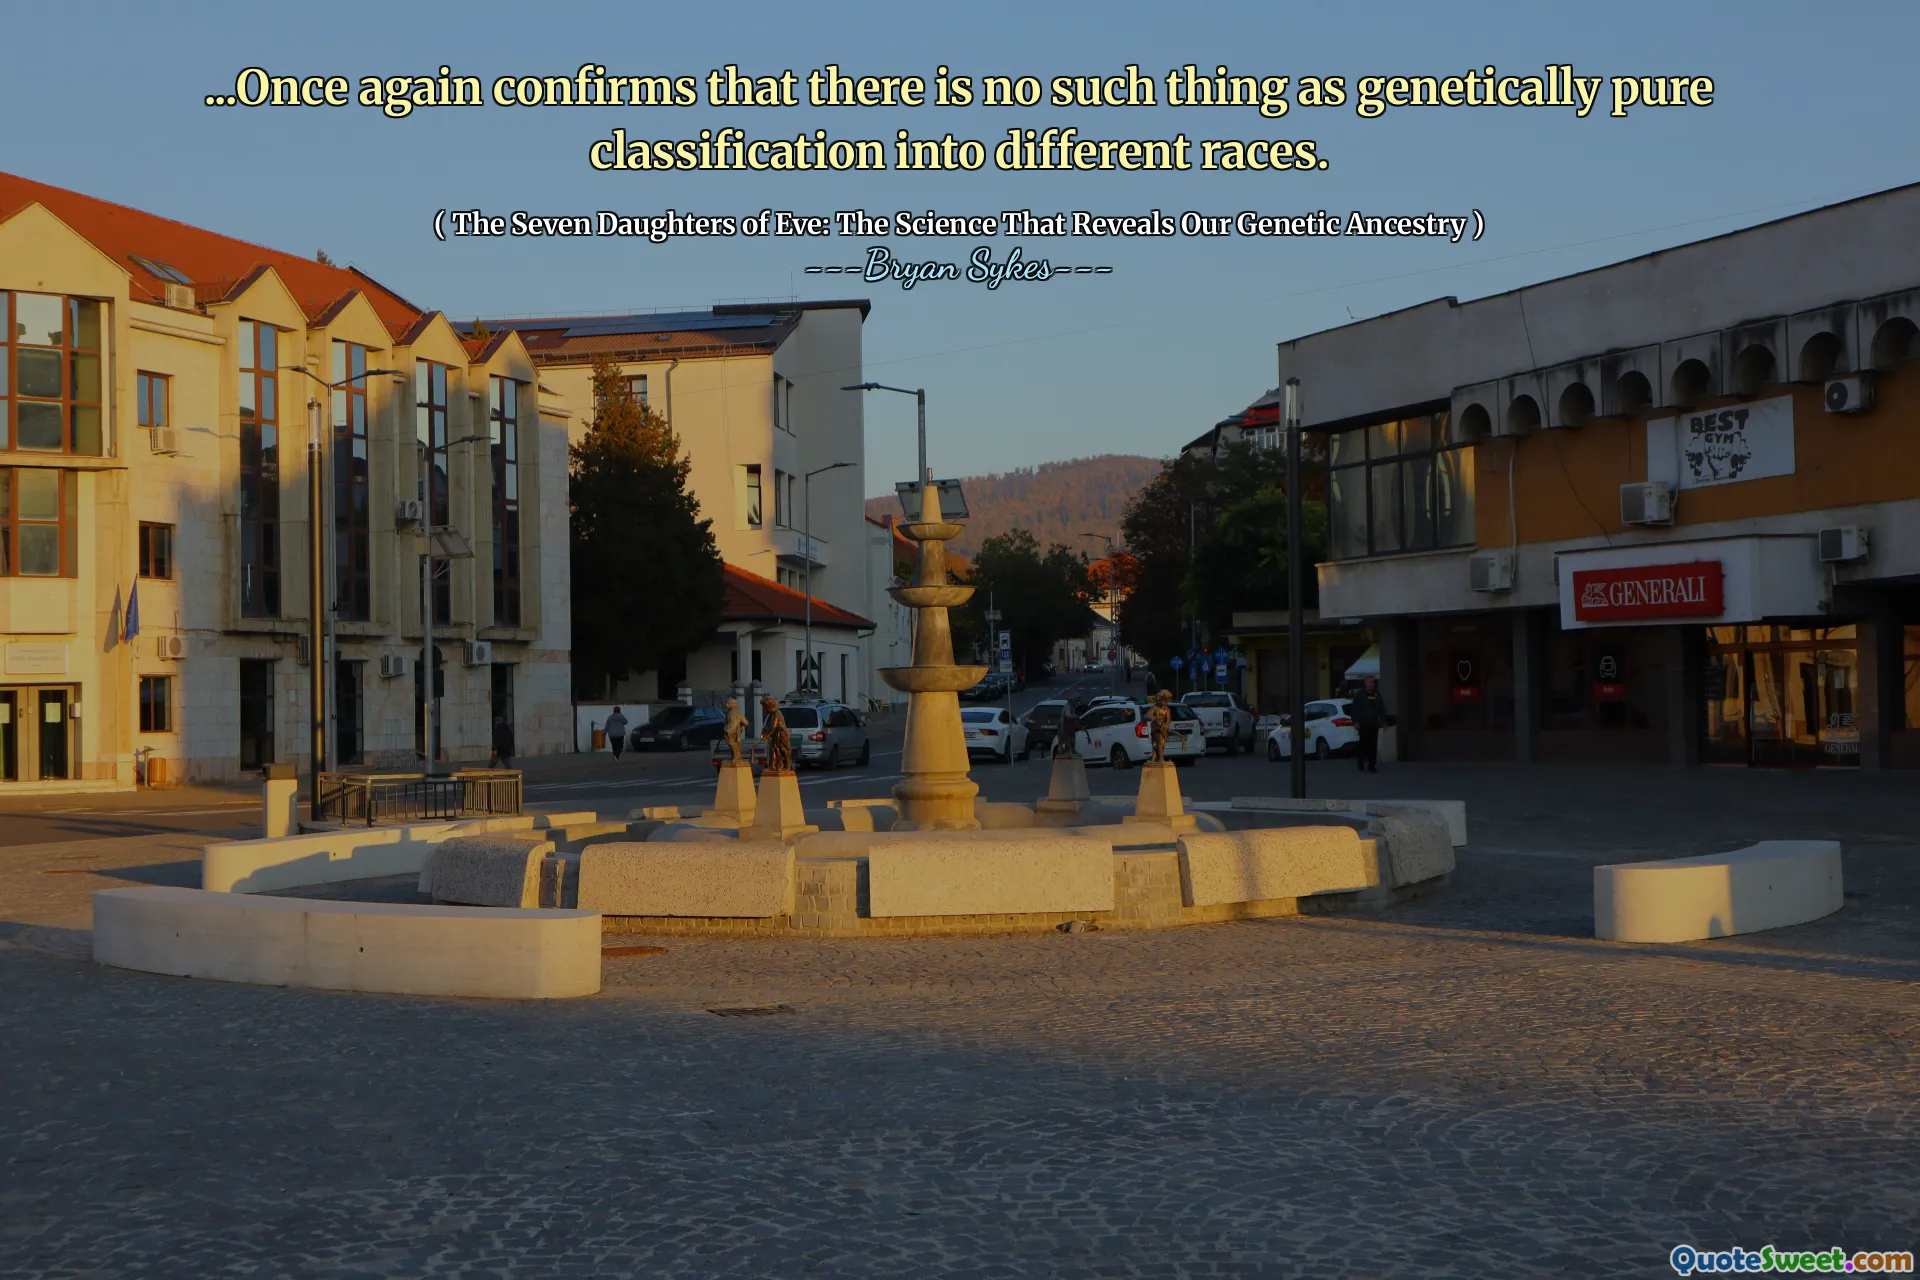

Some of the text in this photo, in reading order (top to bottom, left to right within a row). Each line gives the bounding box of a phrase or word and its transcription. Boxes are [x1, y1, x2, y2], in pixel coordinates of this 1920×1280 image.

[1690, 409, 1750, 433] BEST
[1705, 433, 1734, 444] GYM
[1609, 576, 1706, 607] GENERALI
